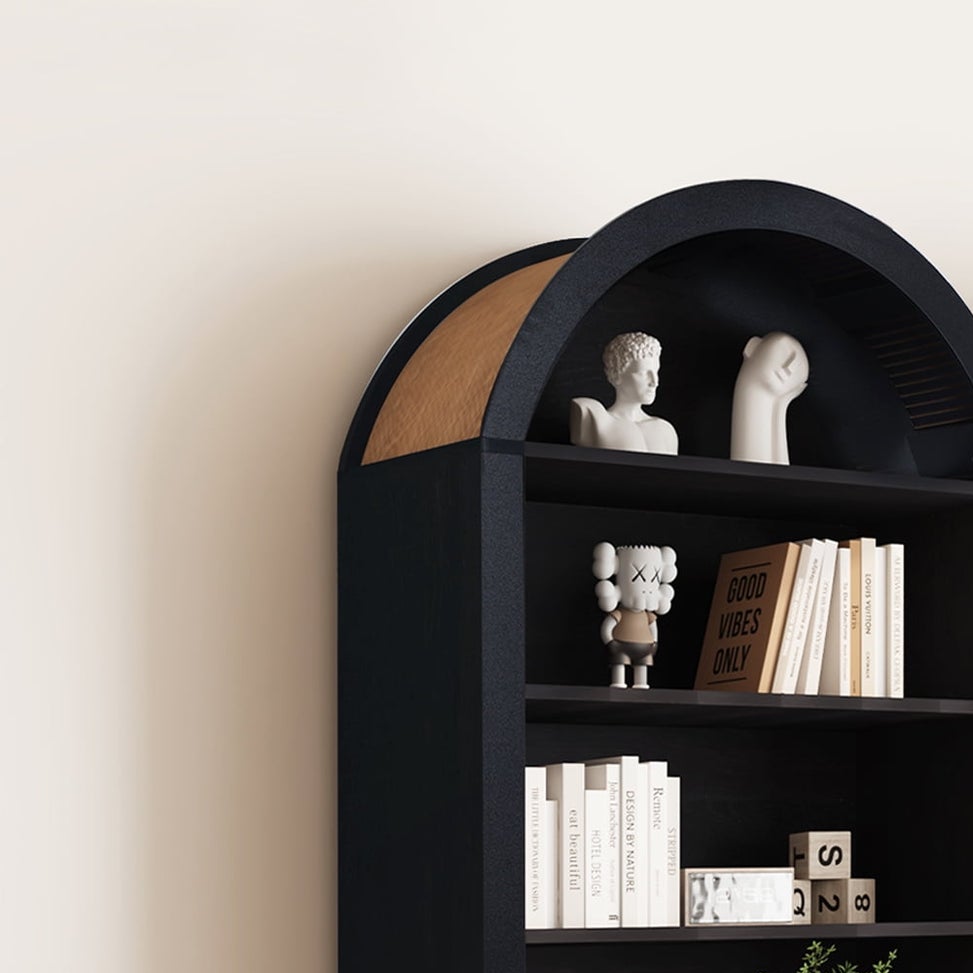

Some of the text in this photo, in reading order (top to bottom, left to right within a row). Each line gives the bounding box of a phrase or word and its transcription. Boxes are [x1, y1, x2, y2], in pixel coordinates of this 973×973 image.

[727, 572, 767, 604] GOOD
[864, 573, 872, 635] LOUIS VUITTON
[718, 607, 761, 639] VIBES
[851, 604, 859, 630] Paris
[712, 645, 751, 675] ONLY
[608, 780, 619, 801] John
[653, 787, 665, 830] Remote
[608, 802, 618, 849] Lanchester
[626, 790, 635, 893] DESIGN BY NATURE
[568, 809, 581, 891] eat beautiful
[591, 829, 602, 897] HOTEL DESIGN
[667, 827, 677, 876] STRIPPED
[818, 844, 843, 867] S
[793, 887, 806, 917] Q
[818, 894, 840, 913] 2
[855, 893, 871, 912] 8
